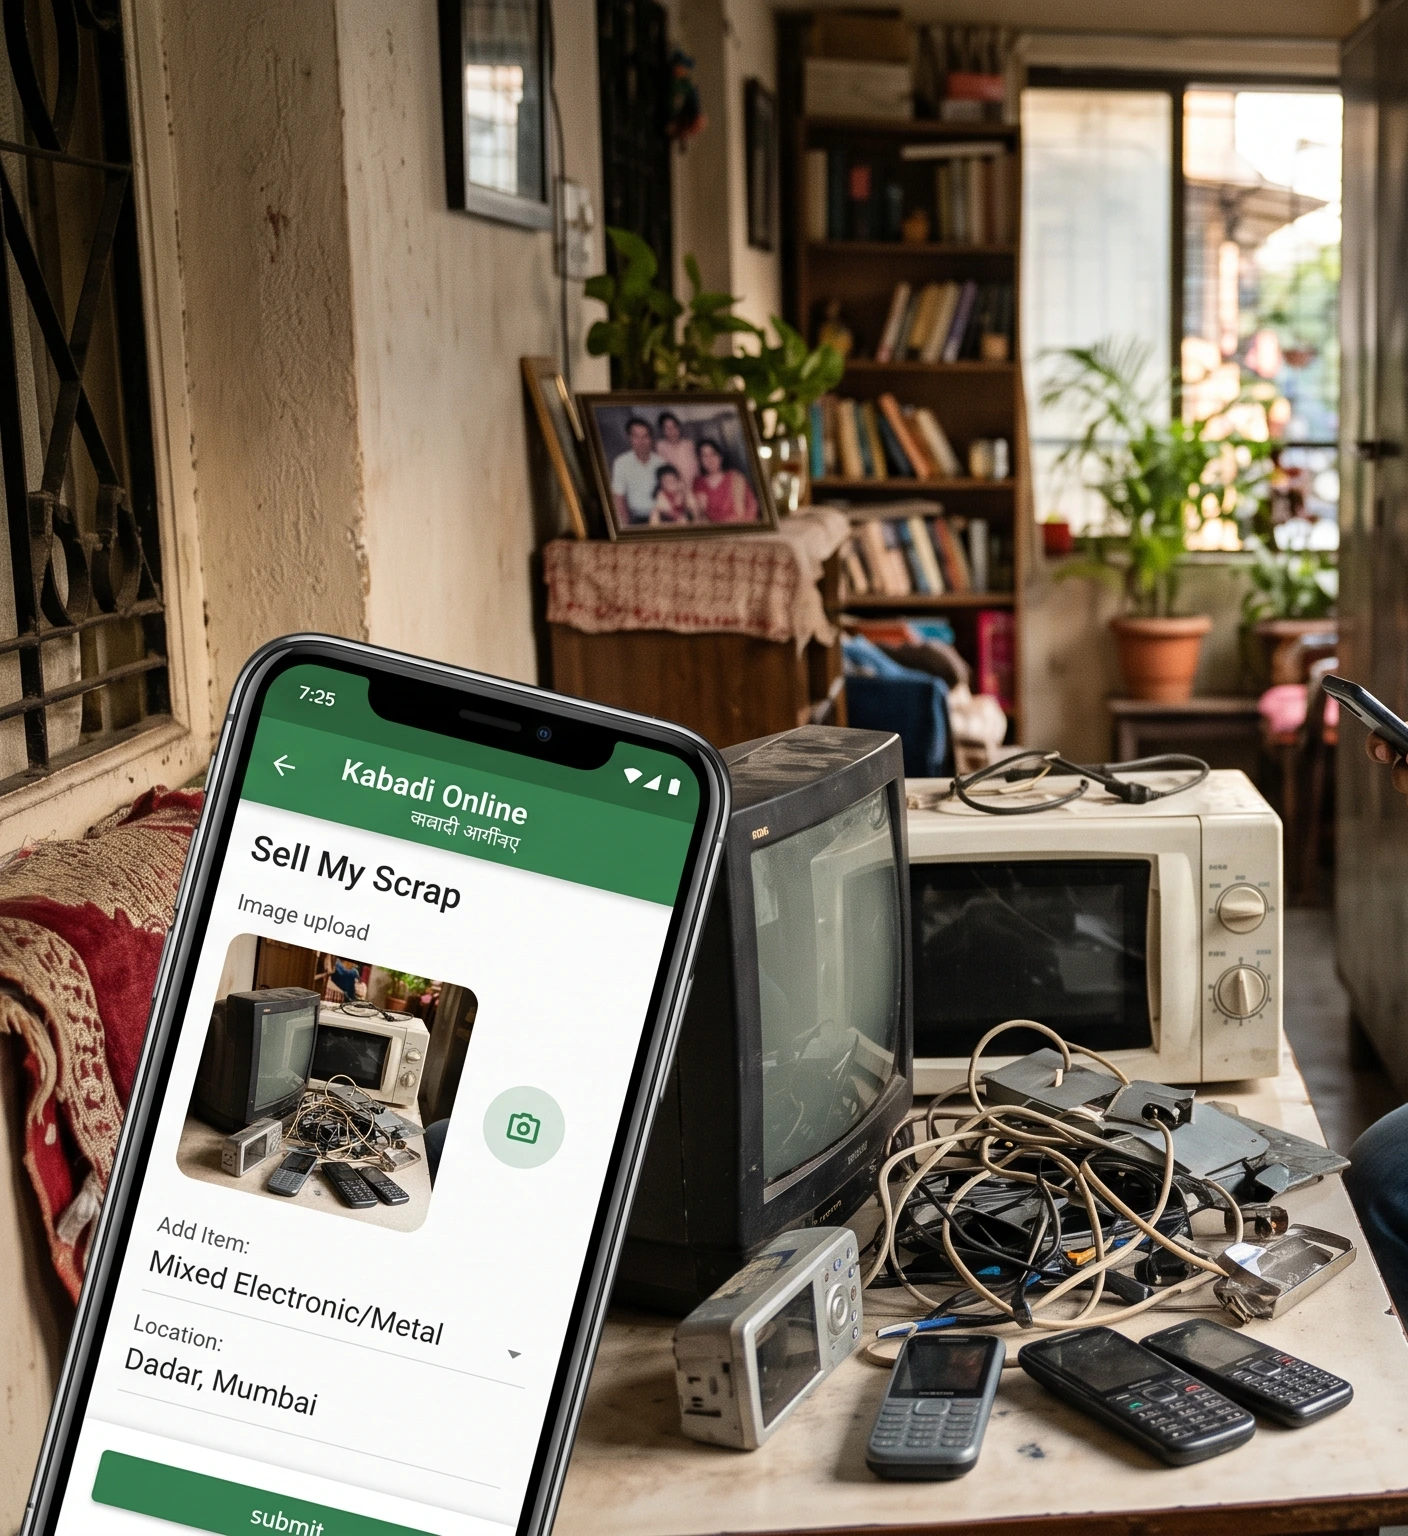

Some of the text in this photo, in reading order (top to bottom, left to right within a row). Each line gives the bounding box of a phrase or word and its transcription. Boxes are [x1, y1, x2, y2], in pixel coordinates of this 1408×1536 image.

[299, 685, 336, 707] 7:25
[341, 758, 528, 826] Kabadi Online
[250, 835, 461, 914] Sell My Scrap
[237, 893, 371, 942] Image upload
[156, 1216, 250, 1255] Add Item:
[149, 1249, 444, 1346] Mixed Electronic/Metal
[133, 1313, 224, 1352] Location:
[124, 1346, 319, 1417] Dadar, Mumbai
[250, 1509, 325, 1536] submit
